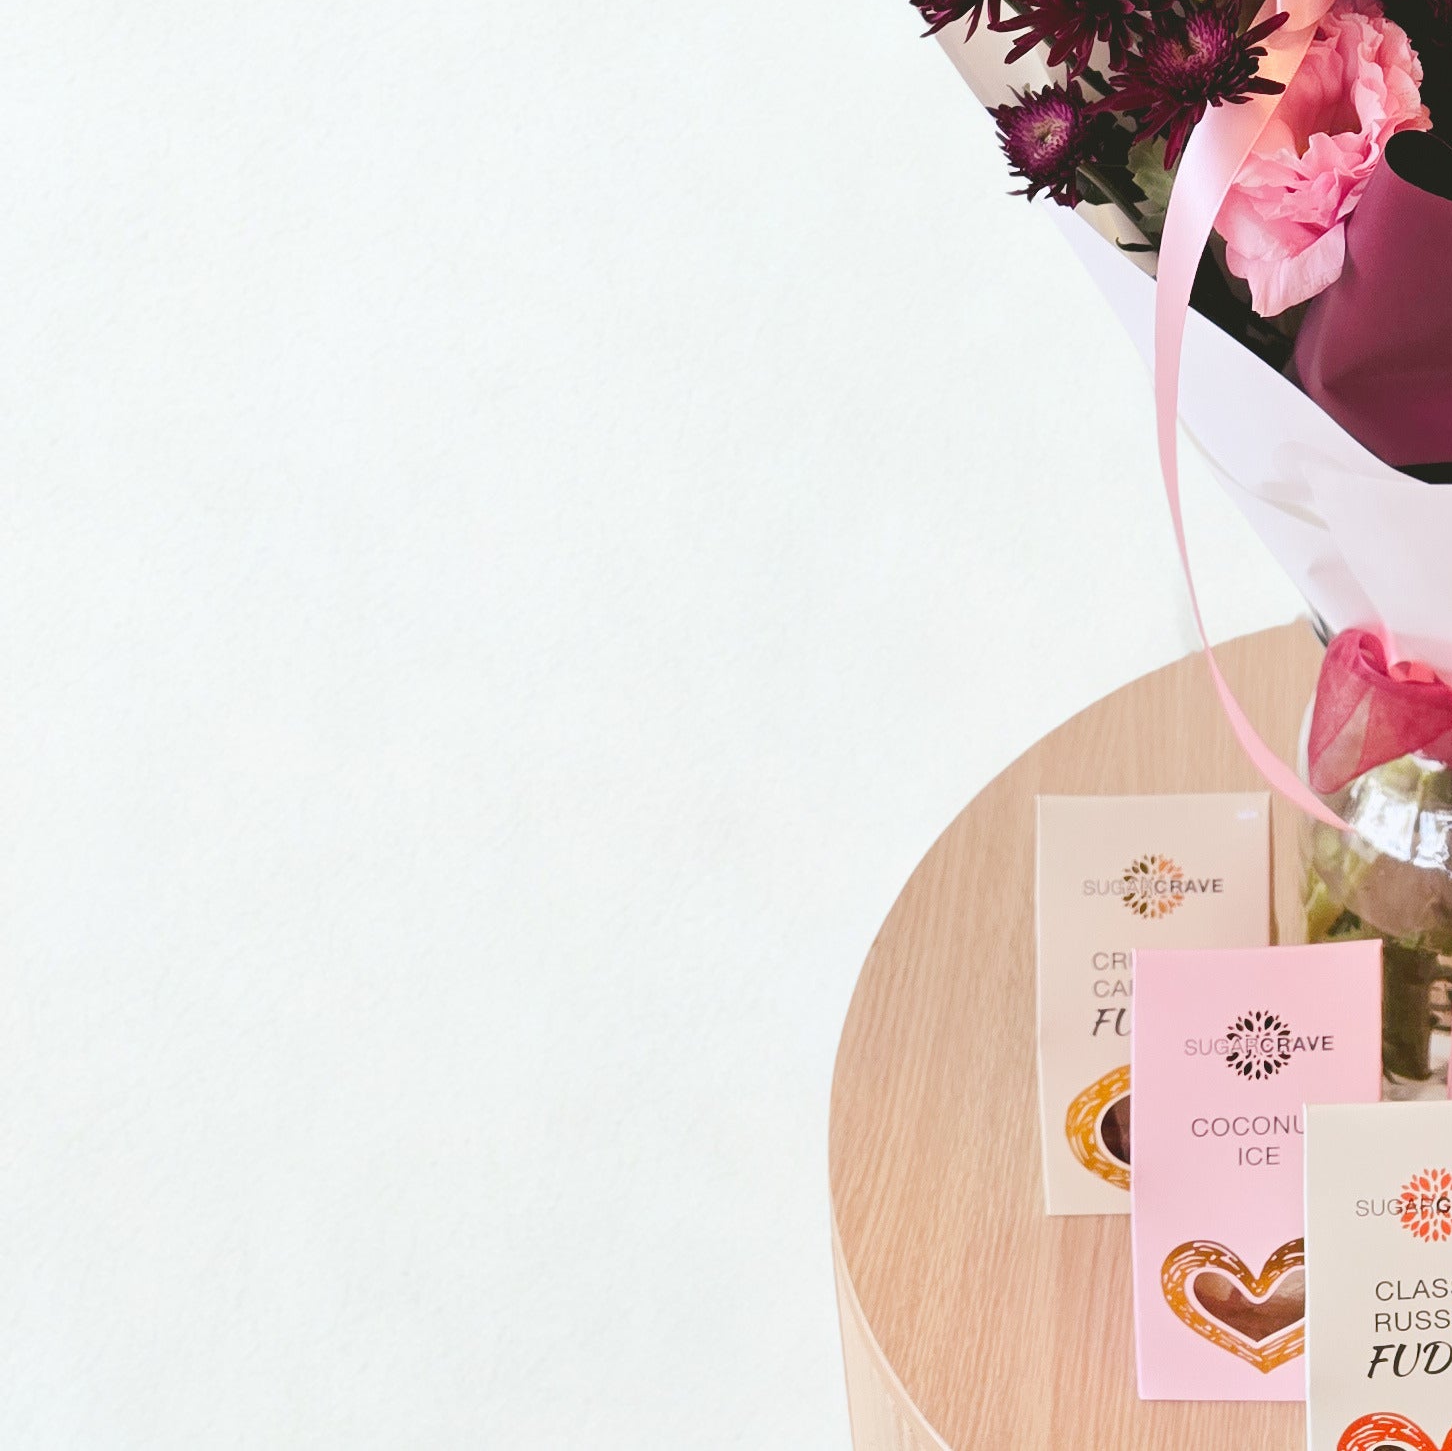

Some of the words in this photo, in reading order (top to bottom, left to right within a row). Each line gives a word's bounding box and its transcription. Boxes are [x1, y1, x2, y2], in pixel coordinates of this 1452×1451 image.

[1093, 952, 1133, 971] CR
[1094, 979, 1133, 998] CA
[1184, 1035, 1335, 1056] SUGARCRAVE
[1238, 1146, 1281, 1166] ICE
